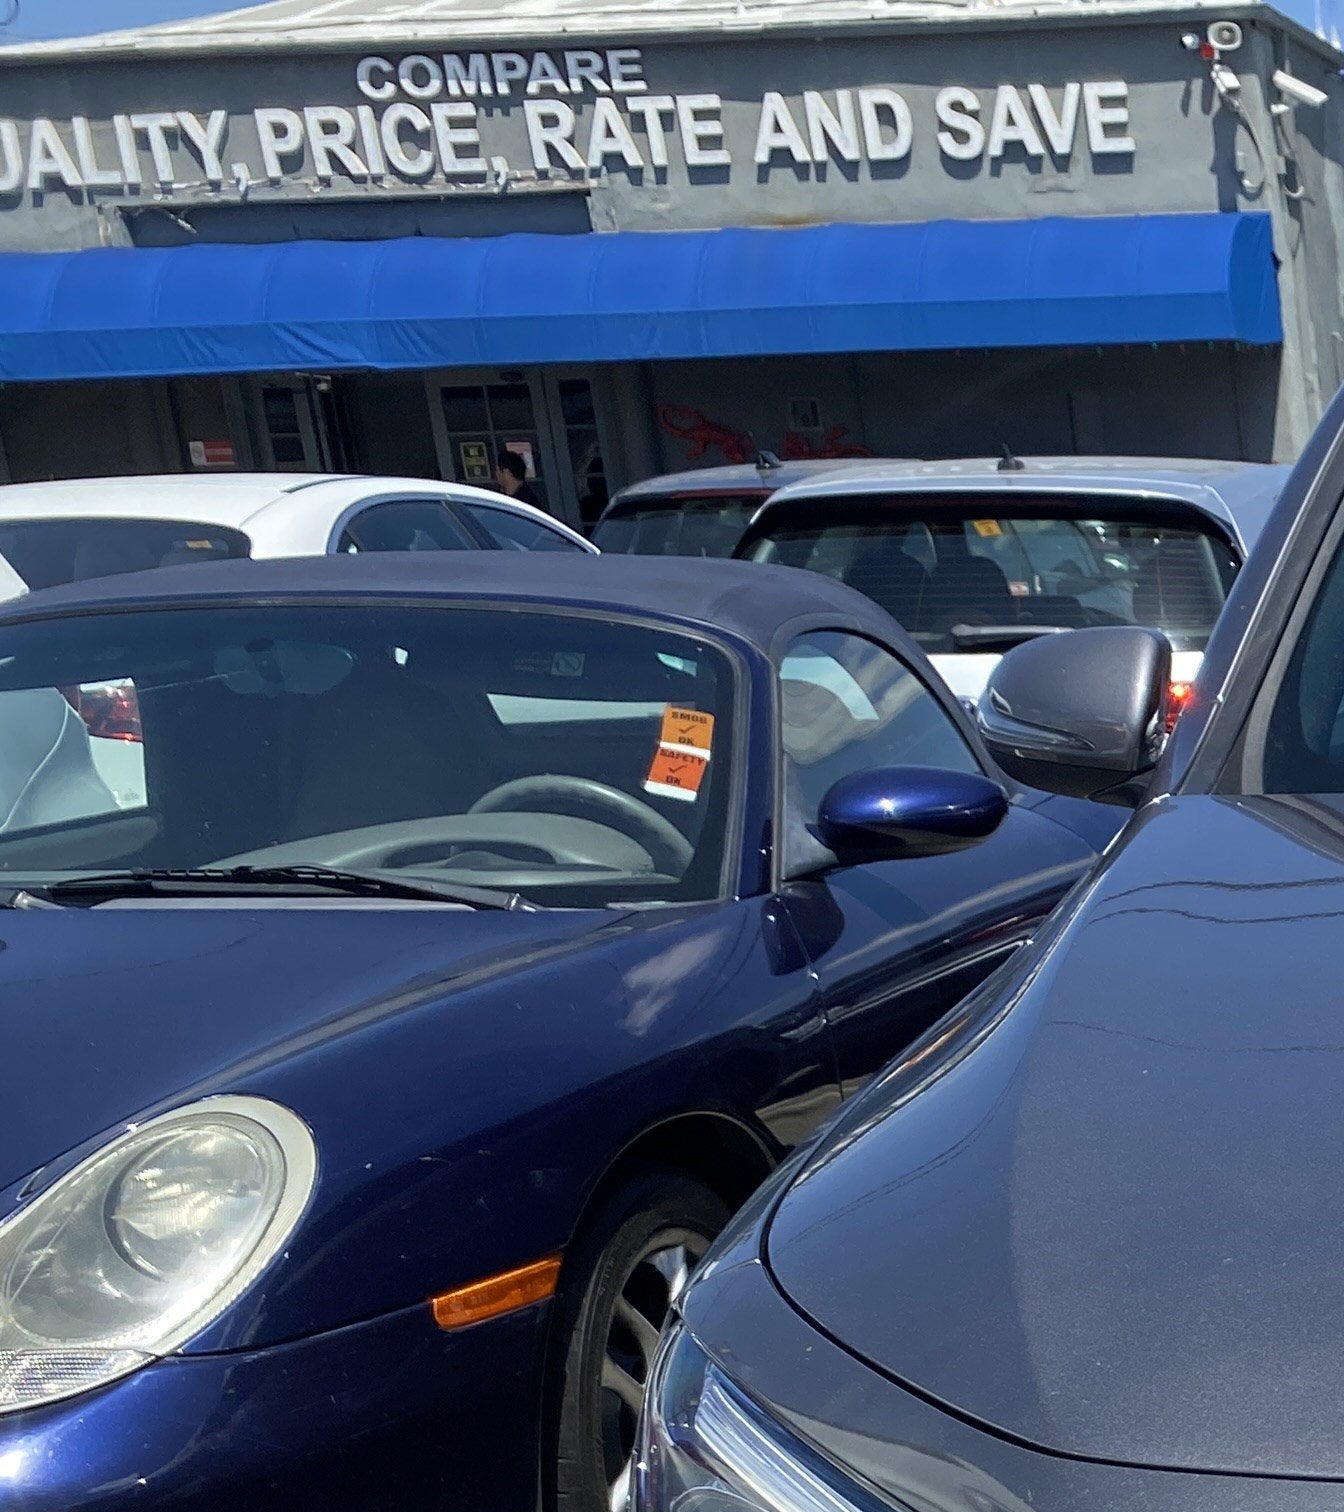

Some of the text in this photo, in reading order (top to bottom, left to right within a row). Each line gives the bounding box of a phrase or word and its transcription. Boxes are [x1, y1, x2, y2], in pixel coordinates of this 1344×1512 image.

[356, 48, 648, 101] COMPARE
[254, 105, 508, 184] PRICE,
[523, 93, 732, 170] RATE
[754, 88, 914, 164] AND
[935, 81, 1136, 161] SAVE
